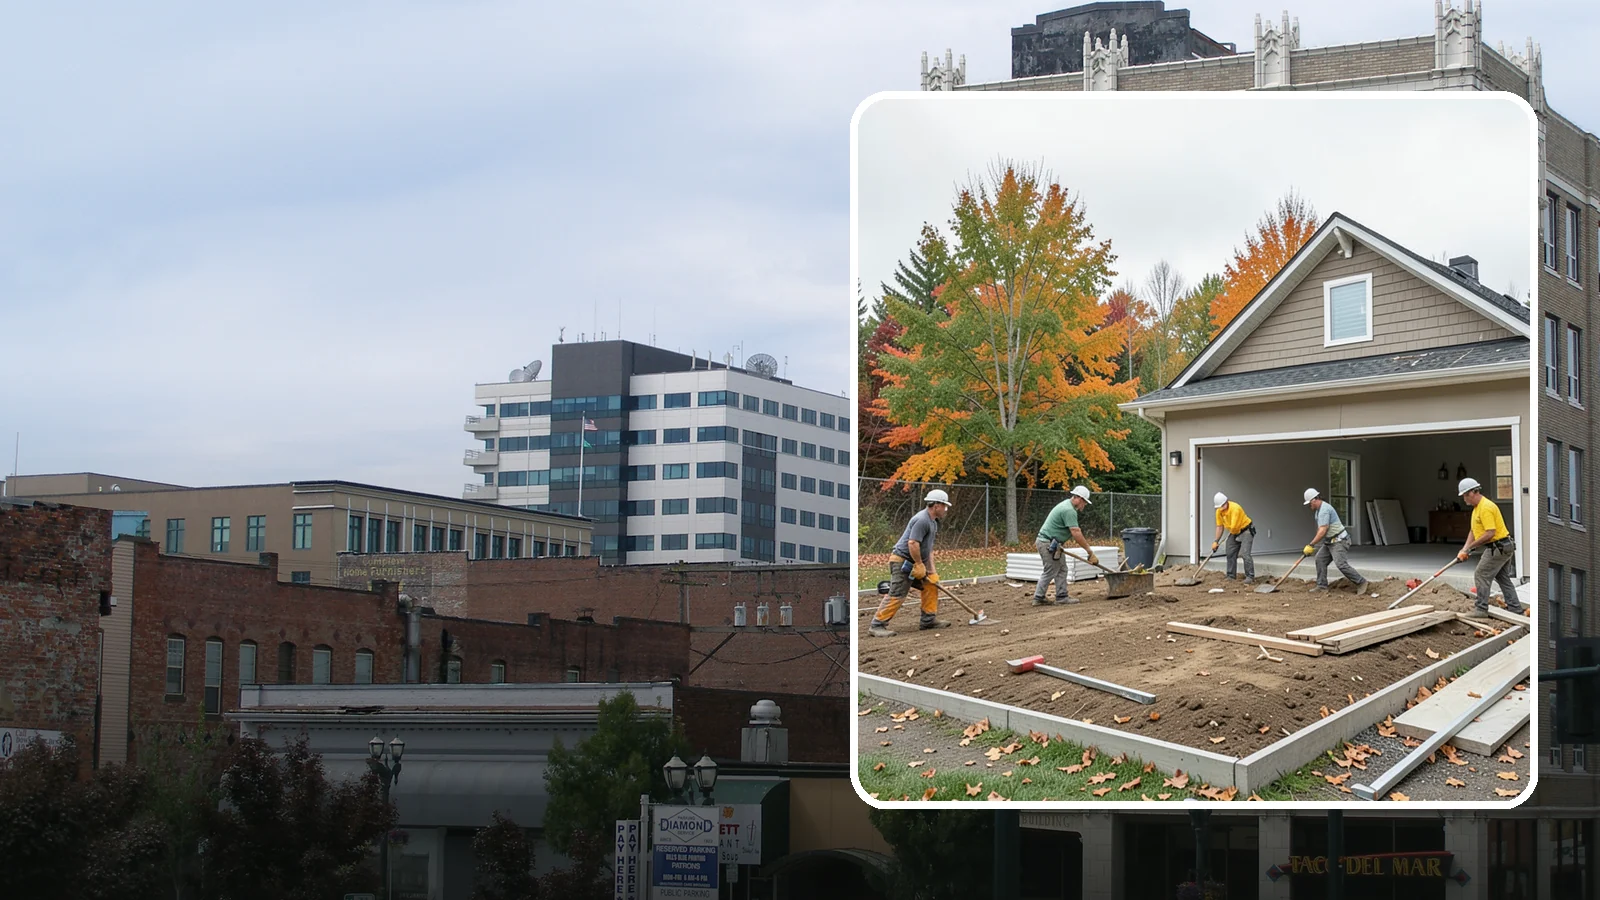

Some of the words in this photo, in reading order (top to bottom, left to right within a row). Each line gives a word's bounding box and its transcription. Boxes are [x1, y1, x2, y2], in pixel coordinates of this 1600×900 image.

[343, 567, 368, 577] Home
[370, 566, 427, 577] Furnishers
[660, 818, 713, 832] DIAMOND
[1022, 814, 1070, 828] BUILDING
[656, 845, 688, 853] RESERVED
[689, 846, 716, 854] PARKING
[721, 851, 739, 863] Soup
[671, 862, 701, 870] PATRONS
[1346, 856, 1385, 875] DEL
[1392, 857, 1442, 877] MAR
[660, 888, 682, 897] PUBLIC
[683, 889, 710, 898] PARKING
